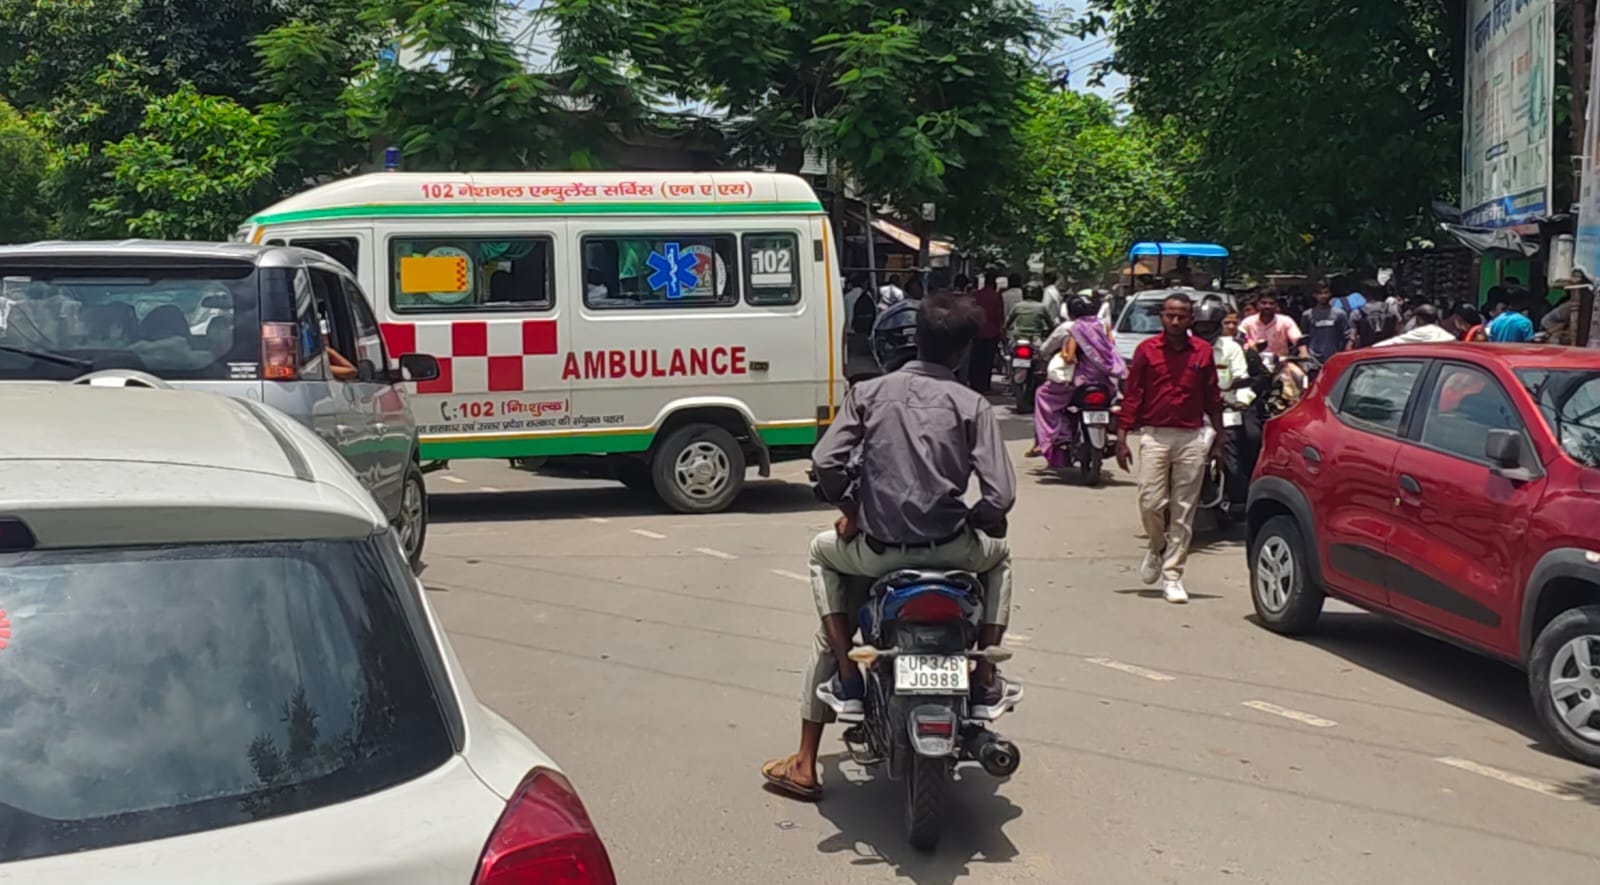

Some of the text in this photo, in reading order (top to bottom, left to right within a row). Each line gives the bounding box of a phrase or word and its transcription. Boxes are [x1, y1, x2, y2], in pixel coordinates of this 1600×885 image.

[422, 184, 454, 198] 102
[529, 182, 597, 204] एम्बुलेंस
[603, 182, 653, 196] सर्विस
[660, 181, 695, 199] (एन
[701, 184, 712, 196] ए
[717, 181, 753, 198] एस)
[752, 250, 790, 272] 102
[561, 346, 746, 380] AMBULANCE
[909, 655, 959, 671] UP34B
